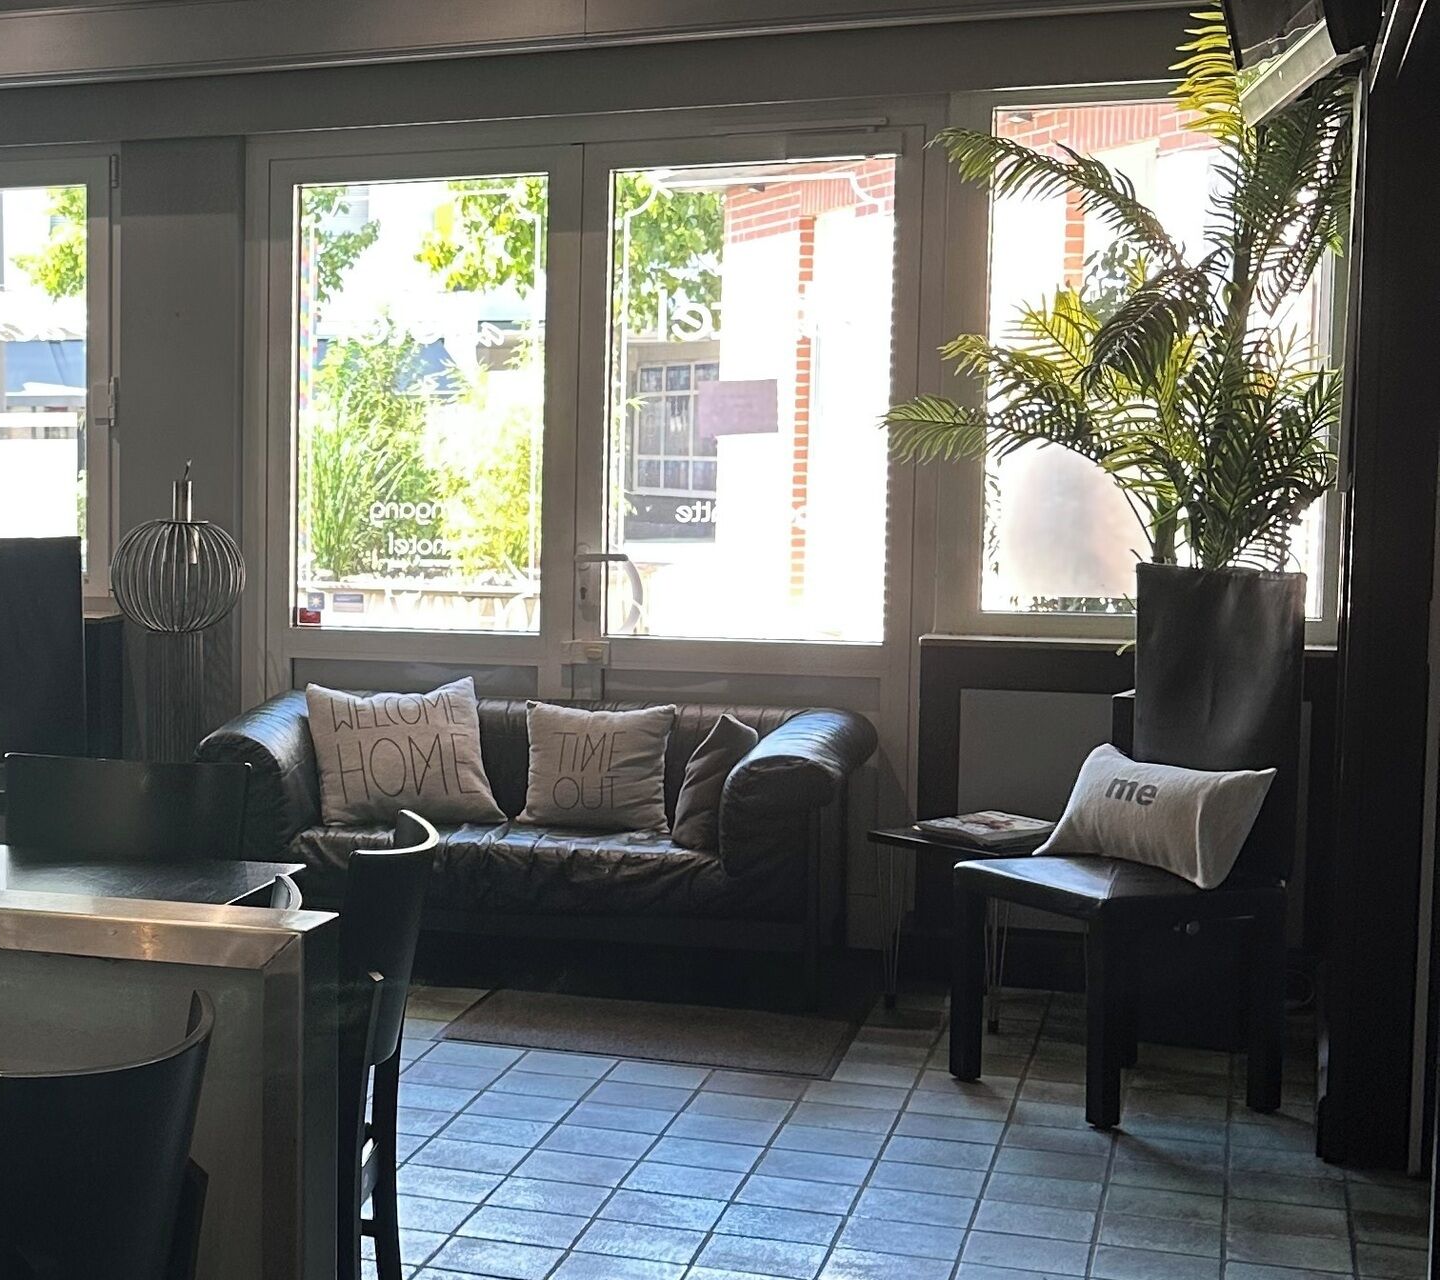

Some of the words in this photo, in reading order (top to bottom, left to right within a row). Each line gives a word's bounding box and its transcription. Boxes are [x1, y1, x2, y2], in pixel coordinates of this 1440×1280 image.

[329, 691, 466, 733] WELCOME
[336, 732, 481, 804] HOME
[553, 730, 627, 773] TIME
[552, 775, 625, 811] OUT
[1105, 776, 1158, 807] me
